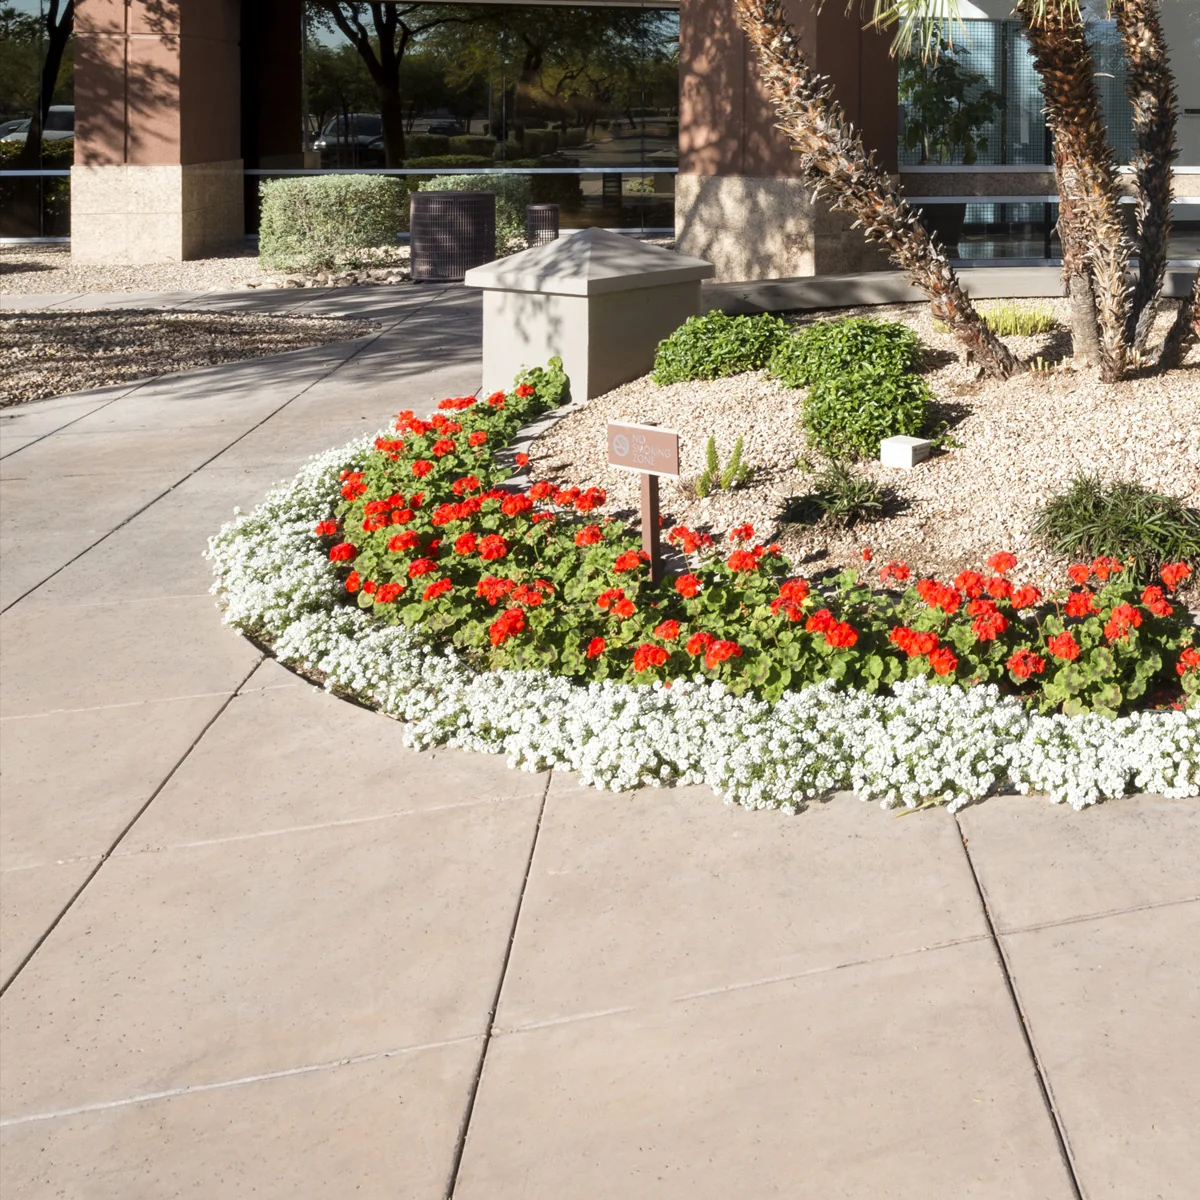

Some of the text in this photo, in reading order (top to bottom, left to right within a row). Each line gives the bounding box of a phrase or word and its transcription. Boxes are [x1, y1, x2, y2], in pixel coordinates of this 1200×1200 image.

[632, 433, 646, 445] NO
[632, 443, 672, 459] SMOKING
[632, 453, 656, 466] ZONE
